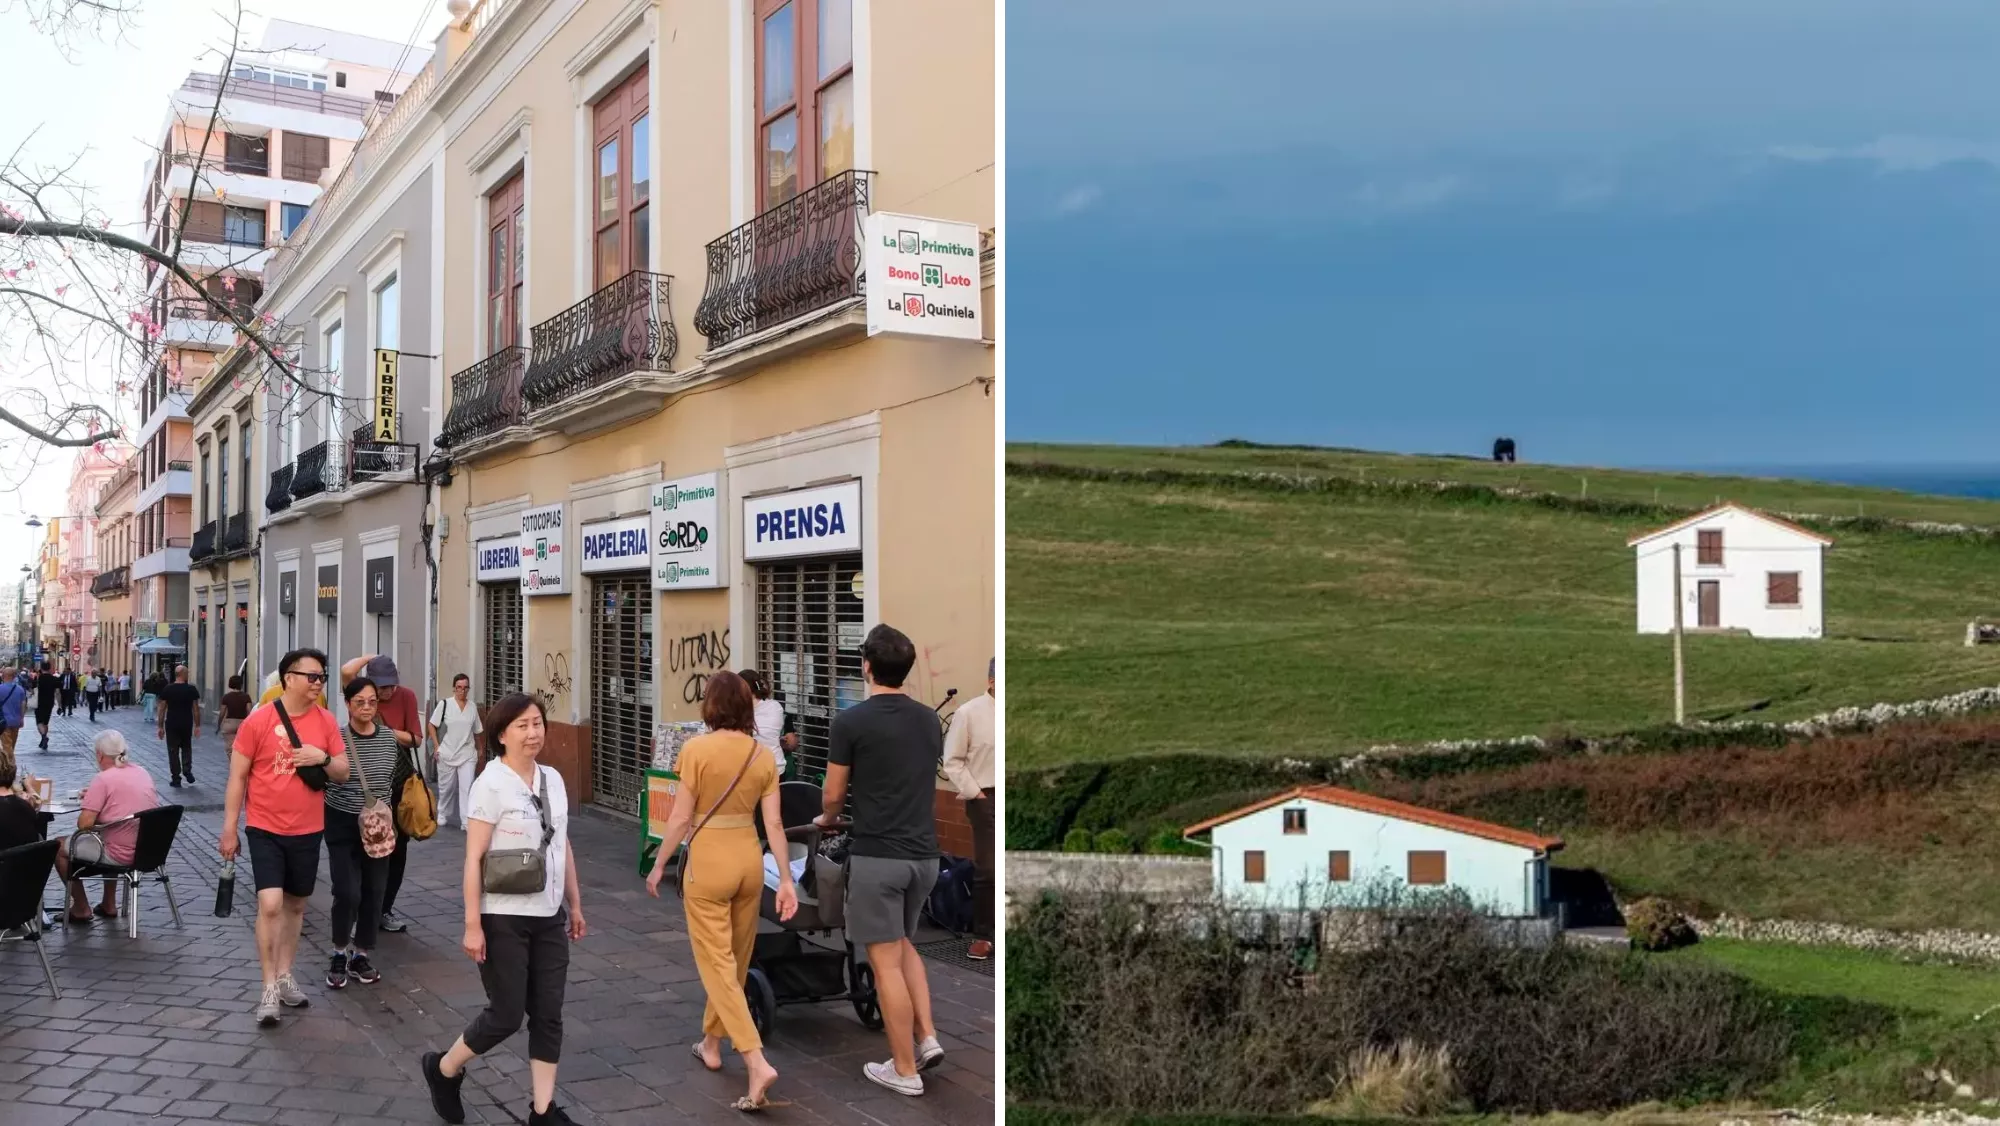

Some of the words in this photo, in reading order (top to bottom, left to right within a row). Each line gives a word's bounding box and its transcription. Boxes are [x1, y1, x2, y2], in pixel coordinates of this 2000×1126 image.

[883, 235, 897, 248] La
[921, 240, 974, 257] Primitiva
[888, 266, 920, 281] Bono
[944, 273, 971, 287] Loto
[888, 299, 902, 311] La
[926, 303, 975, 319] Quiniela
[380, 352, 394, 440] LIBRERIA
[653, 495, 663, 507] La
[678, 486, 715, 503] Primitiva
[522, 509, 561, 533] FOTOCOPIAS
[665, 520, 672, 531] EL
[756, 501, 846, 543] PRENSA
[522, 547, 535, 557] Bono
[548, 543, 561, 553] Loto
[584, 528, 648, 560] PAPELERIA
[480, 545, 520, 571] LIBRERIA
[522, 578, 529, 587] La
[539, 575, 561, 588] Quiniela
[657, 569, 666, 579] La
[679, 566, 710, 578] Primitiva
